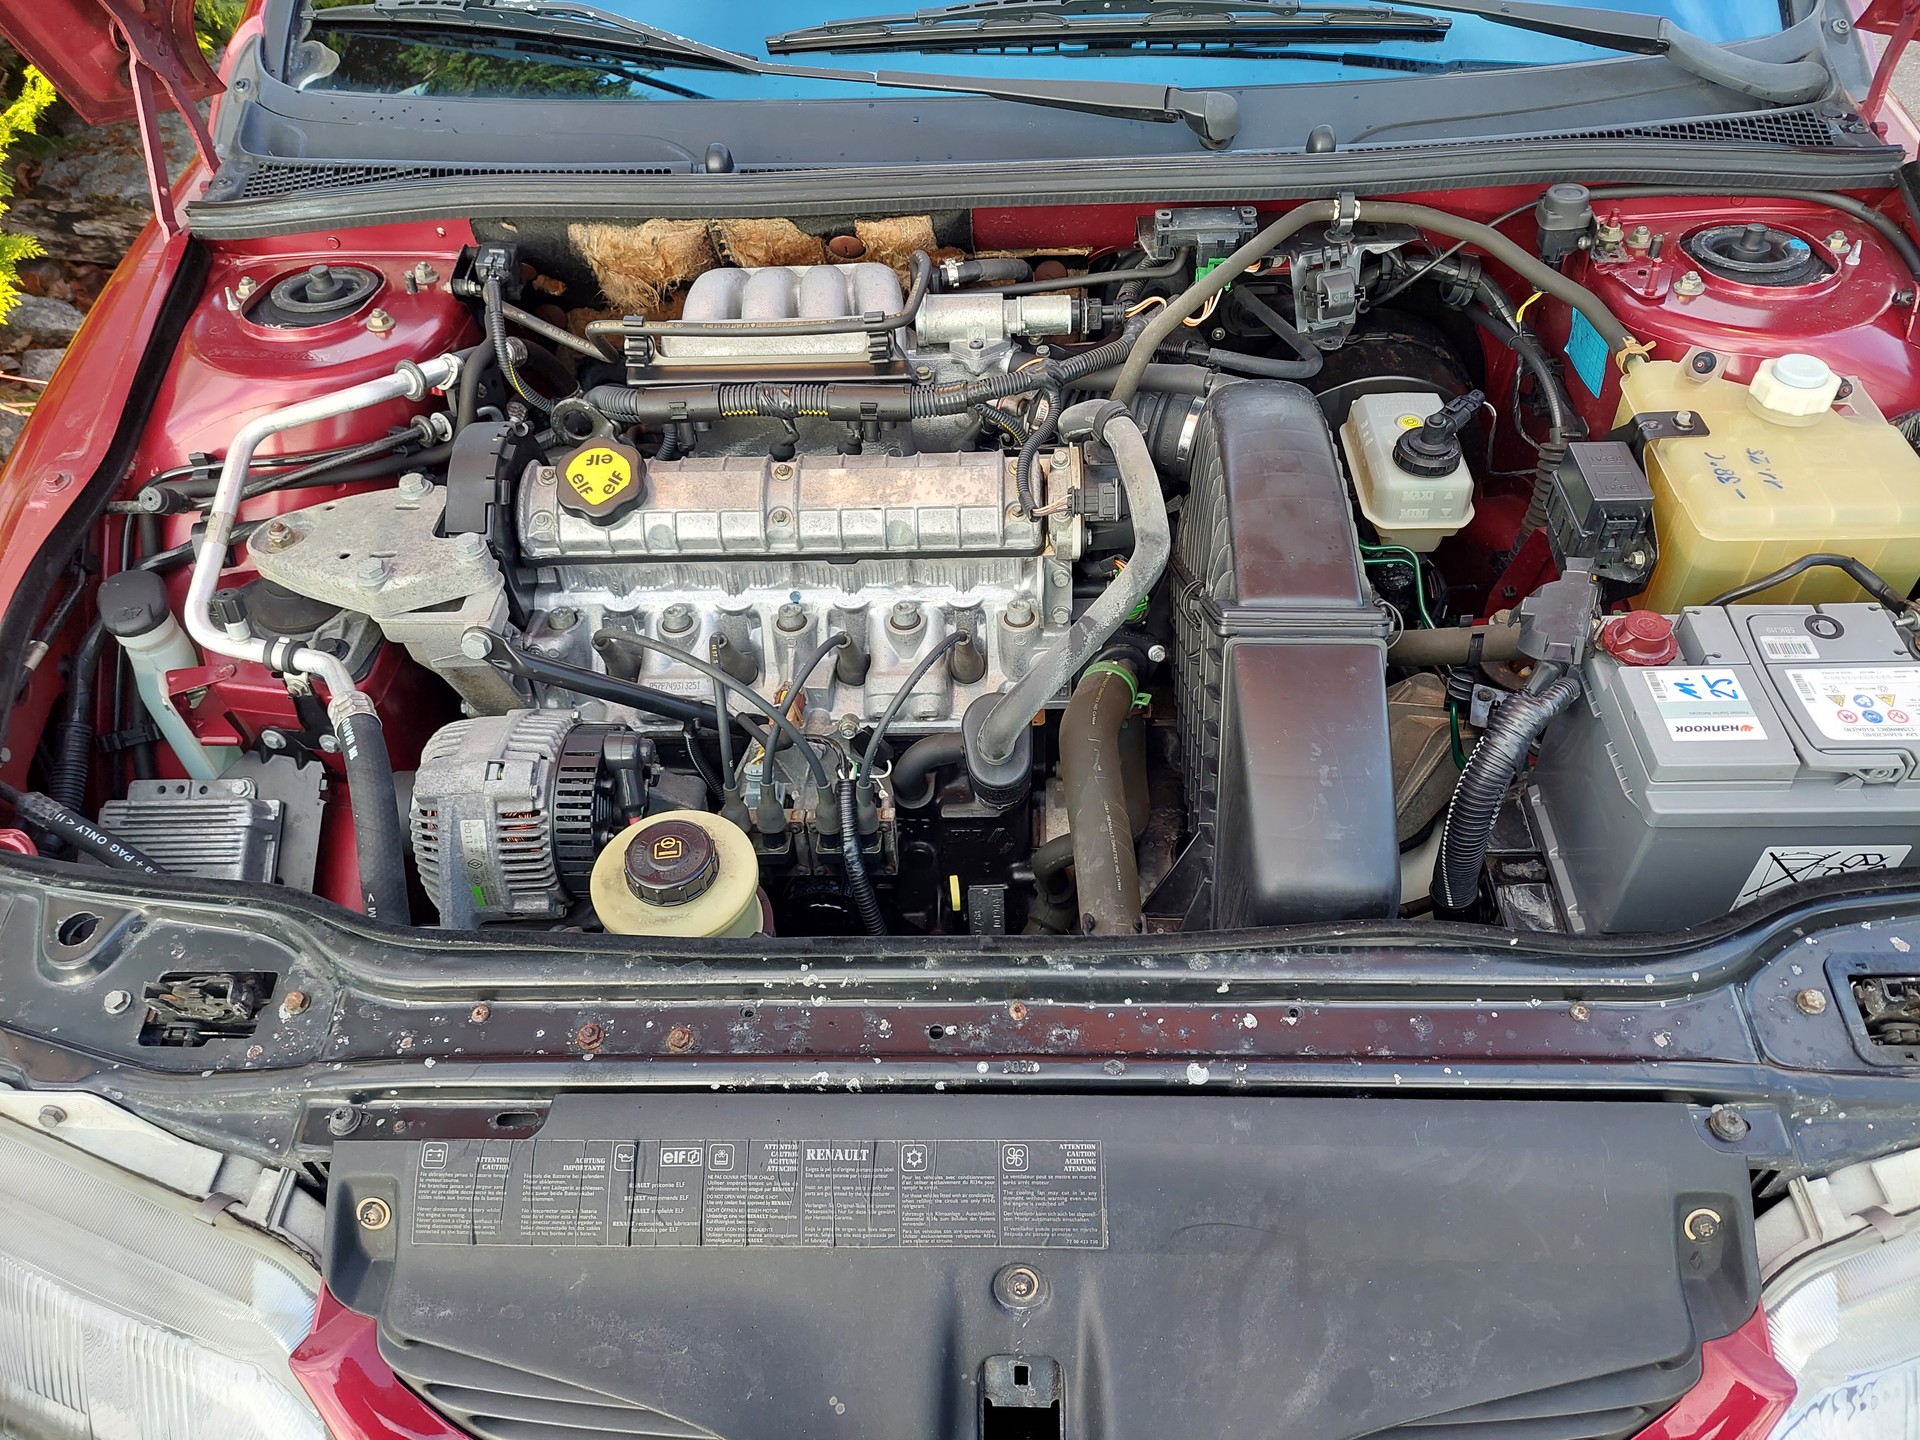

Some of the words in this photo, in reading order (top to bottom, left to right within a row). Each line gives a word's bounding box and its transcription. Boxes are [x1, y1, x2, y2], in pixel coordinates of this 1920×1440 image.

[586, 454, 613, 466] elf
[572, 474, 594, 494] elf
[603, 470, 623, 495] elf
[1402, 491, 1436, 501] MAXI
[75, 824, 108, 845] ONLY
[109, 843, 135, 862] PAG
[663, 1151, 686, 1164] elf
[806, 1149, 869, 1160] RENAULT
